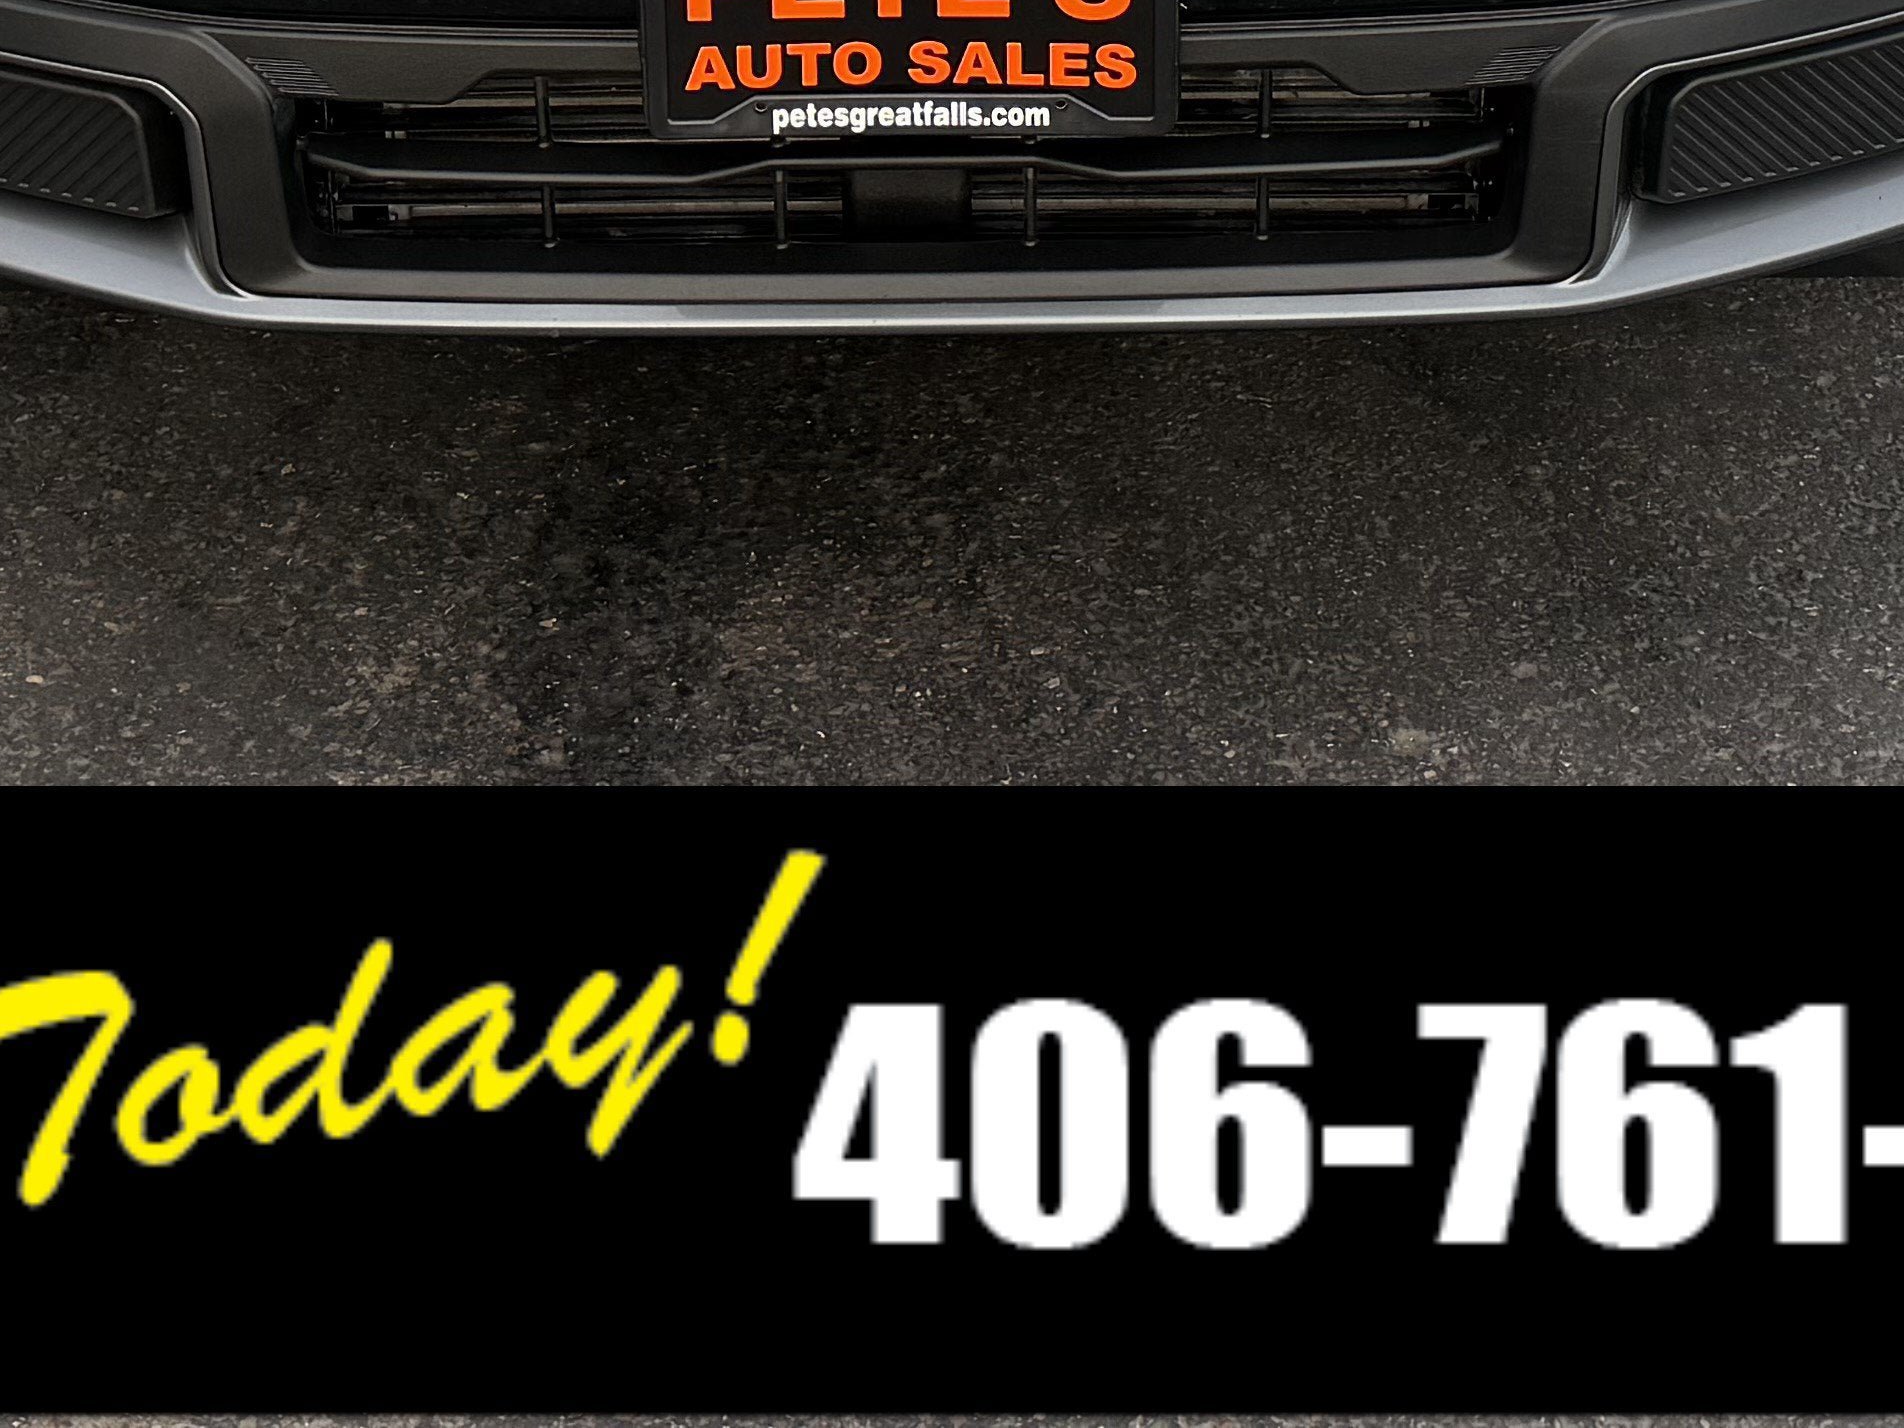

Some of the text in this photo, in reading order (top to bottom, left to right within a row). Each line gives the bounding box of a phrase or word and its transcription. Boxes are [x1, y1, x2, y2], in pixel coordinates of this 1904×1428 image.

[685, 41, 1137, 91] AUTO SALES
[772, 100, 1051, 134] petesgreatfalls.com
